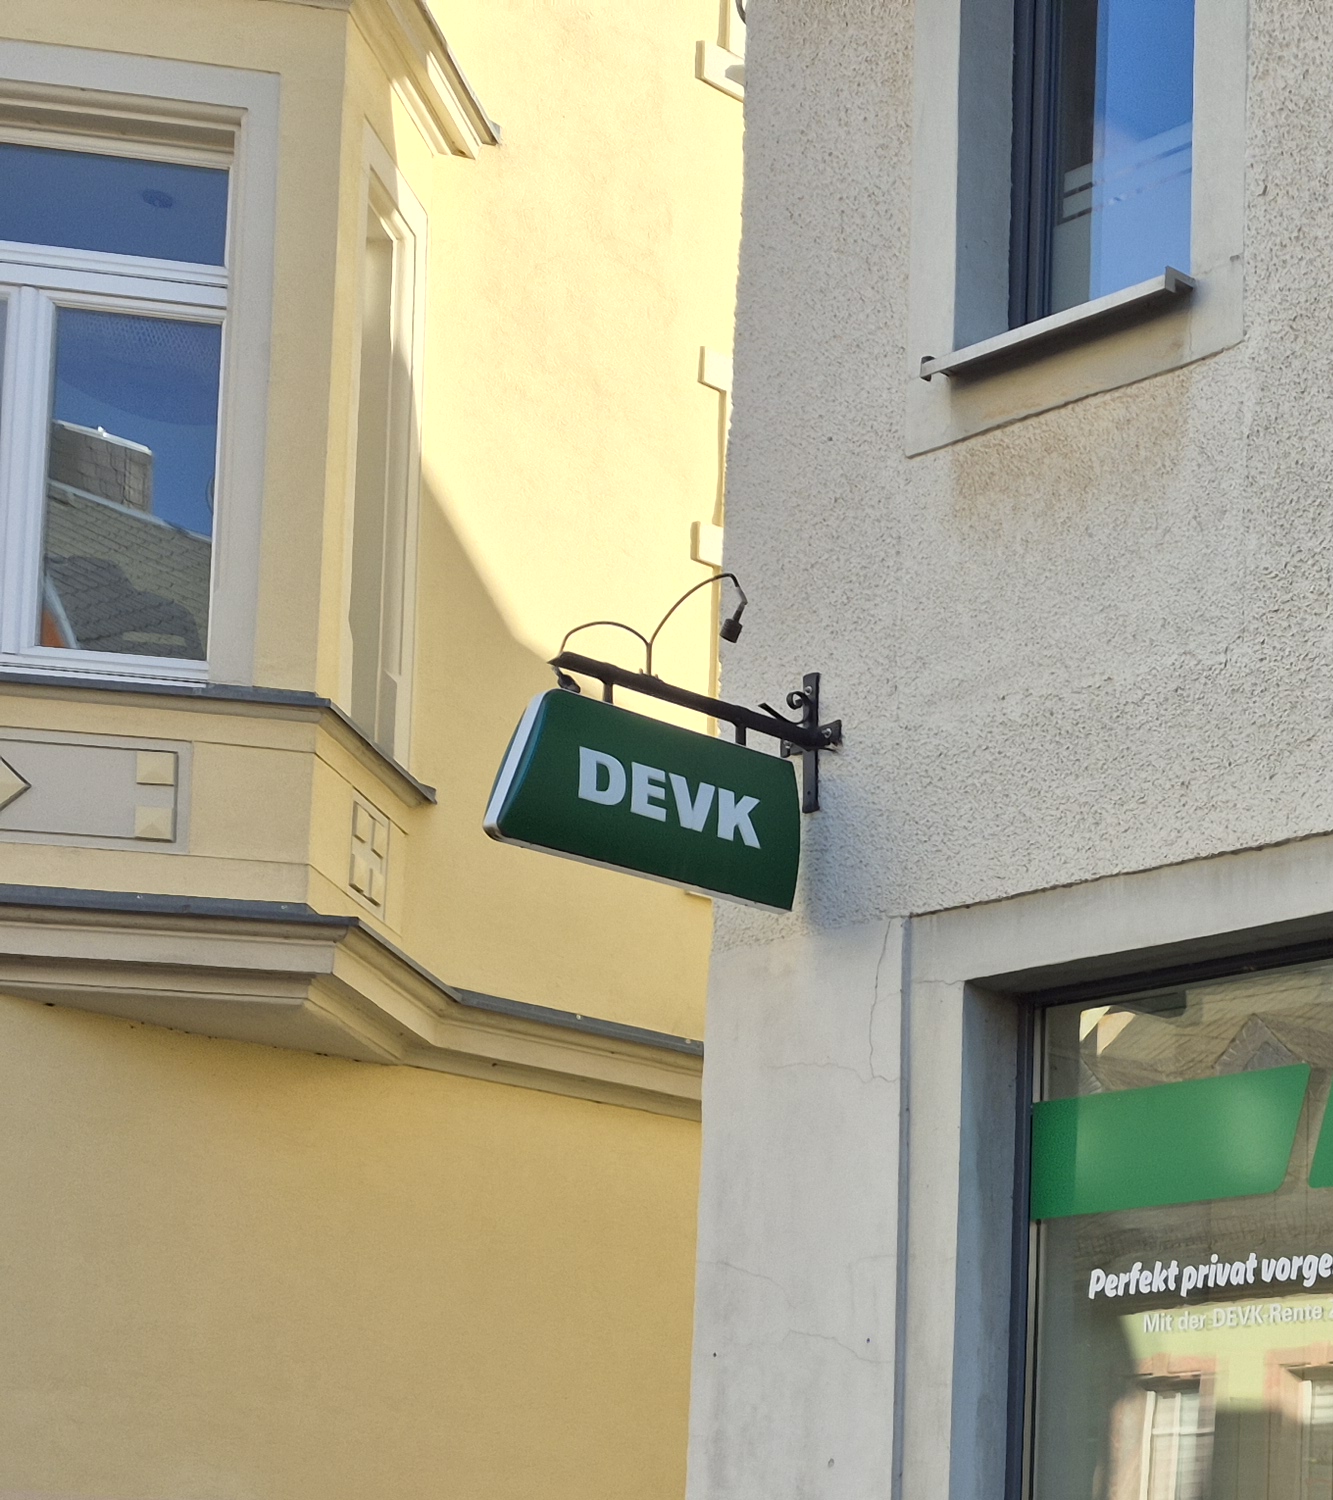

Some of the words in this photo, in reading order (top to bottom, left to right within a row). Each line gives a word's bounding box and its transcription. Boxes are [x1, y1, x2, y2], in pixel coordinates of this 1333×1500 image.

[578, 746, 761, 849] DEVK
[1089, 1260, 1179, 1300] Perfekt
[1180, 1252, 1257, 1297] privat
[1143, 1313, 1174, 1333] Mit
[1178, 1311, 1206, 1330] der
[1212, 1303, 1323, 1328] DEVK-Rente
